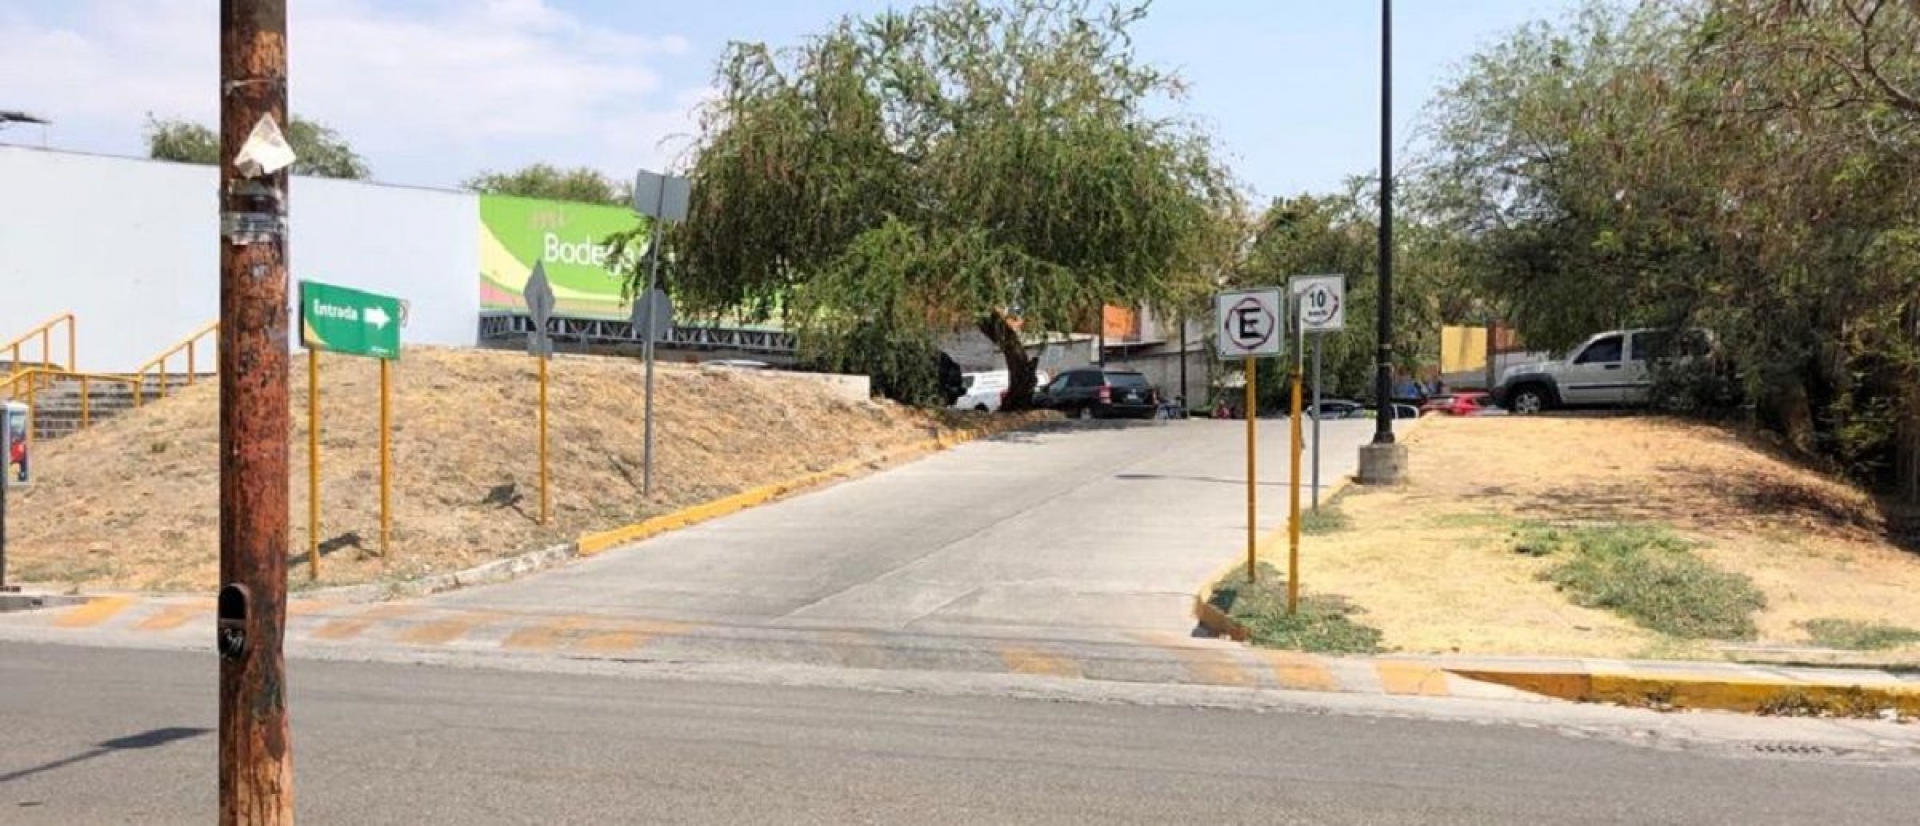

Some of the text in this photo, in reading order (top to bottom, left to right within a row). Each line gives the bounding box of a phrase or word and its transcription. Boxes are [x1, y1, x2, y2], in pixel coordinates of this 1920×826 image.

[313, 298, 358, 321] Entrada
[1309, 290, 1326, 308] 10
[1239, 307, 1262, 339] E
